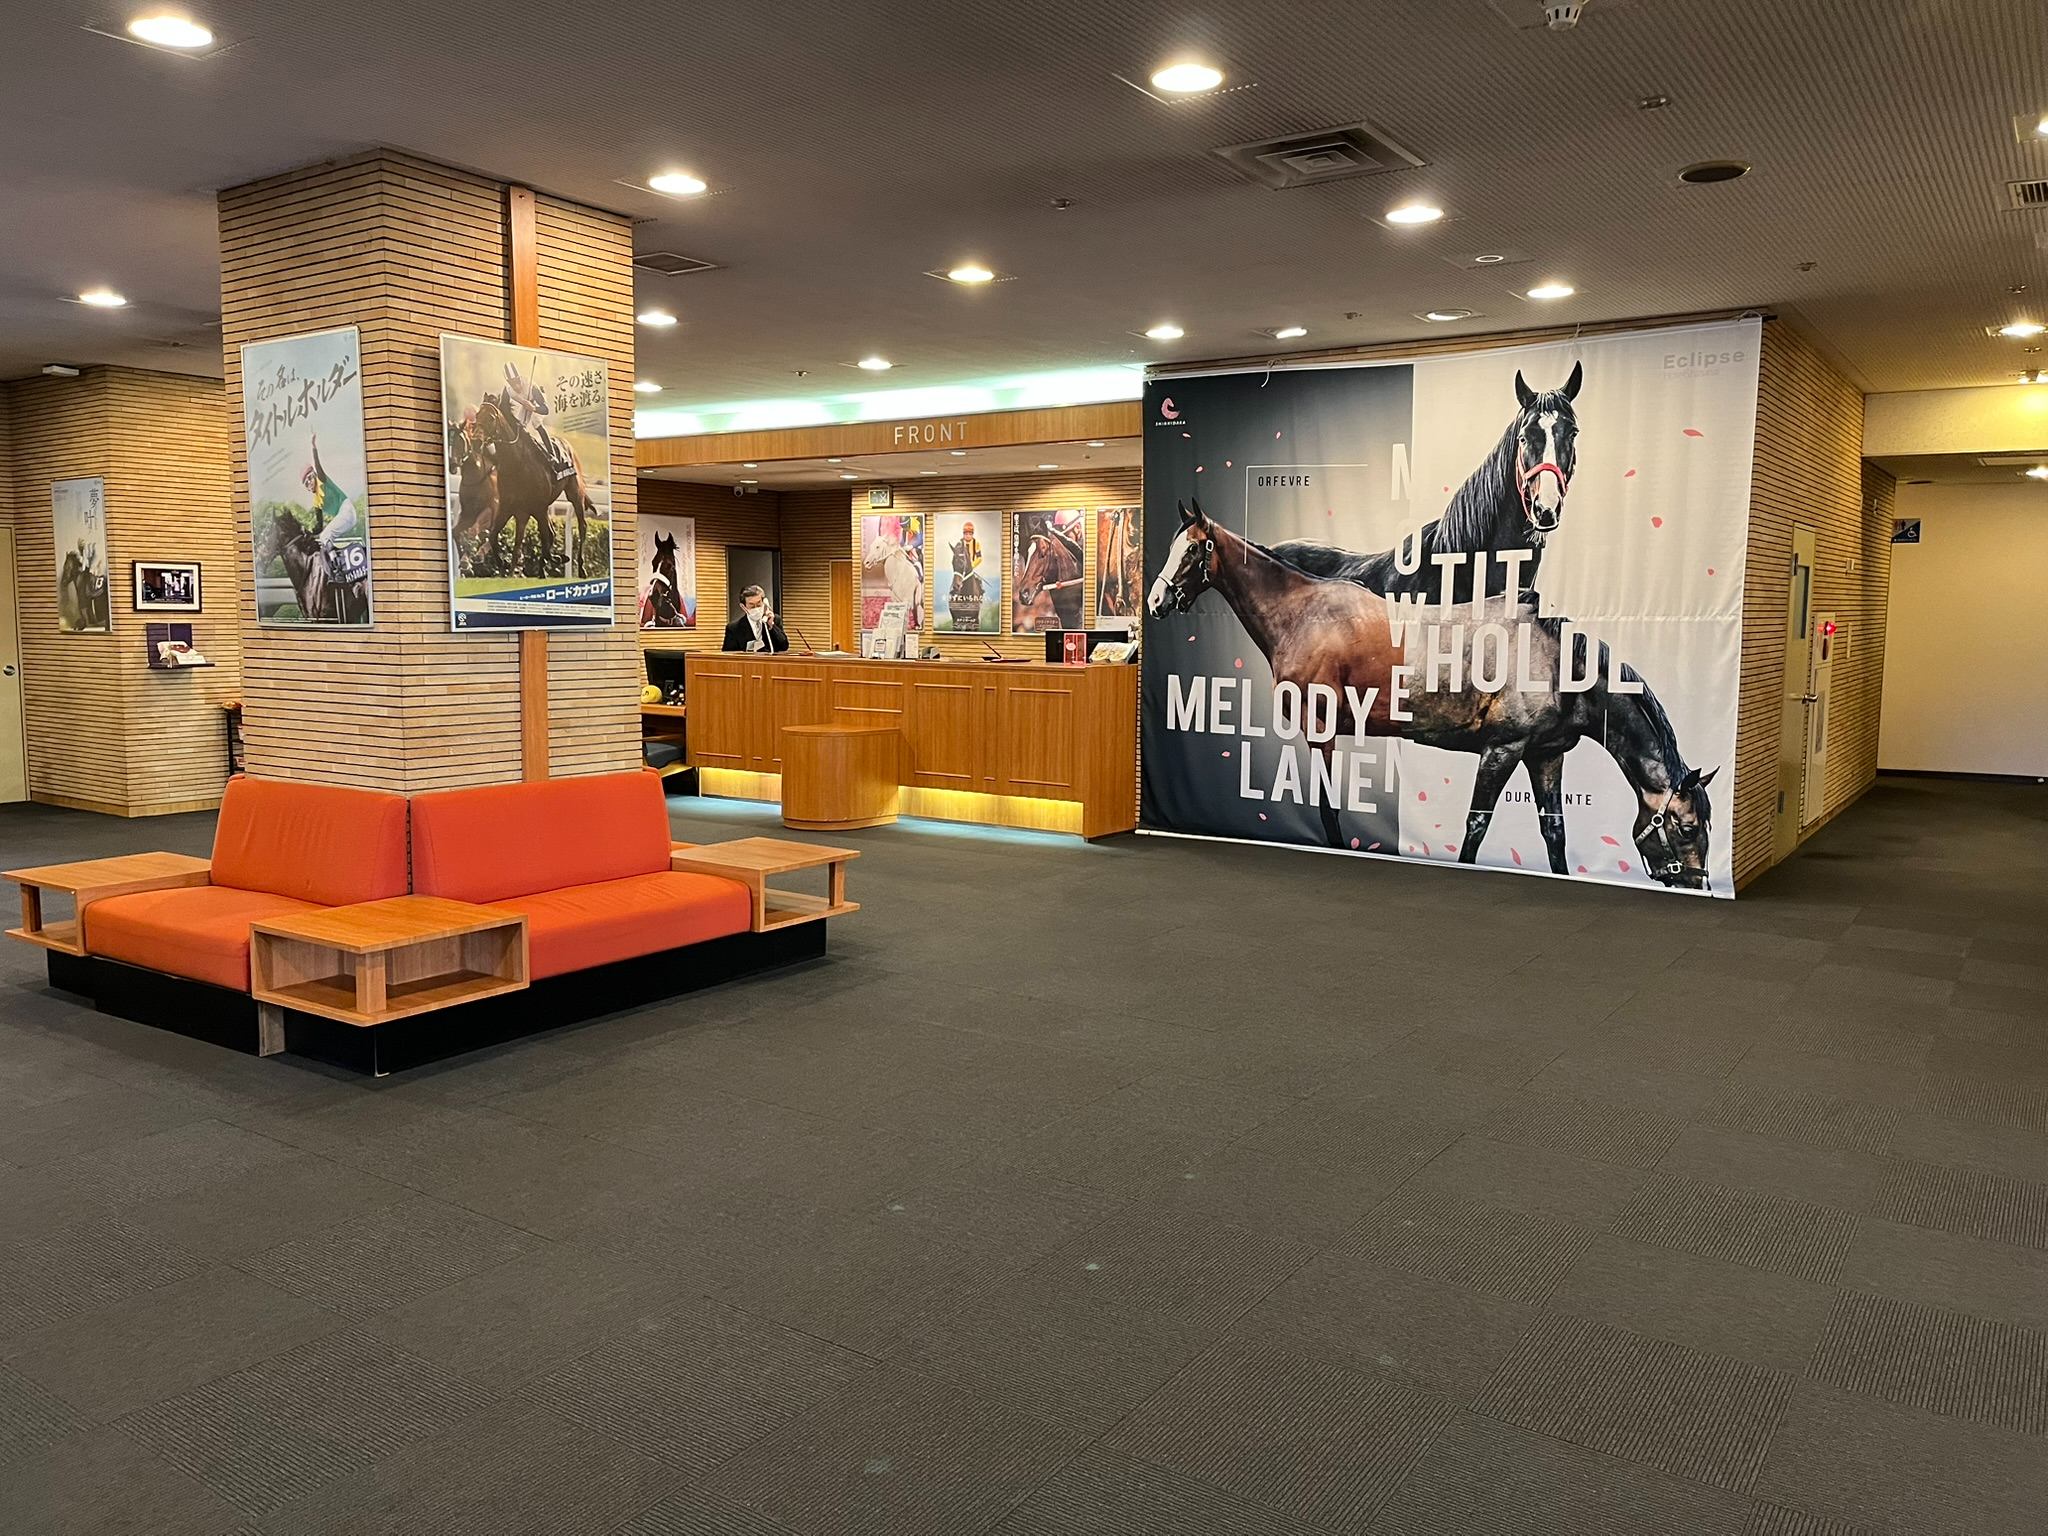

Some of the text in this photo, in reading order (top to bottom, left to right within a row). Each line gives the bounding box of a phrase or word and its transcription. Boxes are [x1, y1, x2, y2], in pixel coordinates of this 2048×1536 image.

[1664, 351, 1745, 369] Eclipse
[248, 354, 358, 453] タイトルホルダー
[554, 389, 606, 414] 海を渡る。
[894, 421, 968, 445] FRONT
[1258, 475, 1311, 487] ORFEVRE
[343, 546, 364, 571] 16
[545, 581, 609, 601] ロードカナロア
[1166, 673, 1380, 748] MELODY
[1239, 740, 1378, 814] LANE
